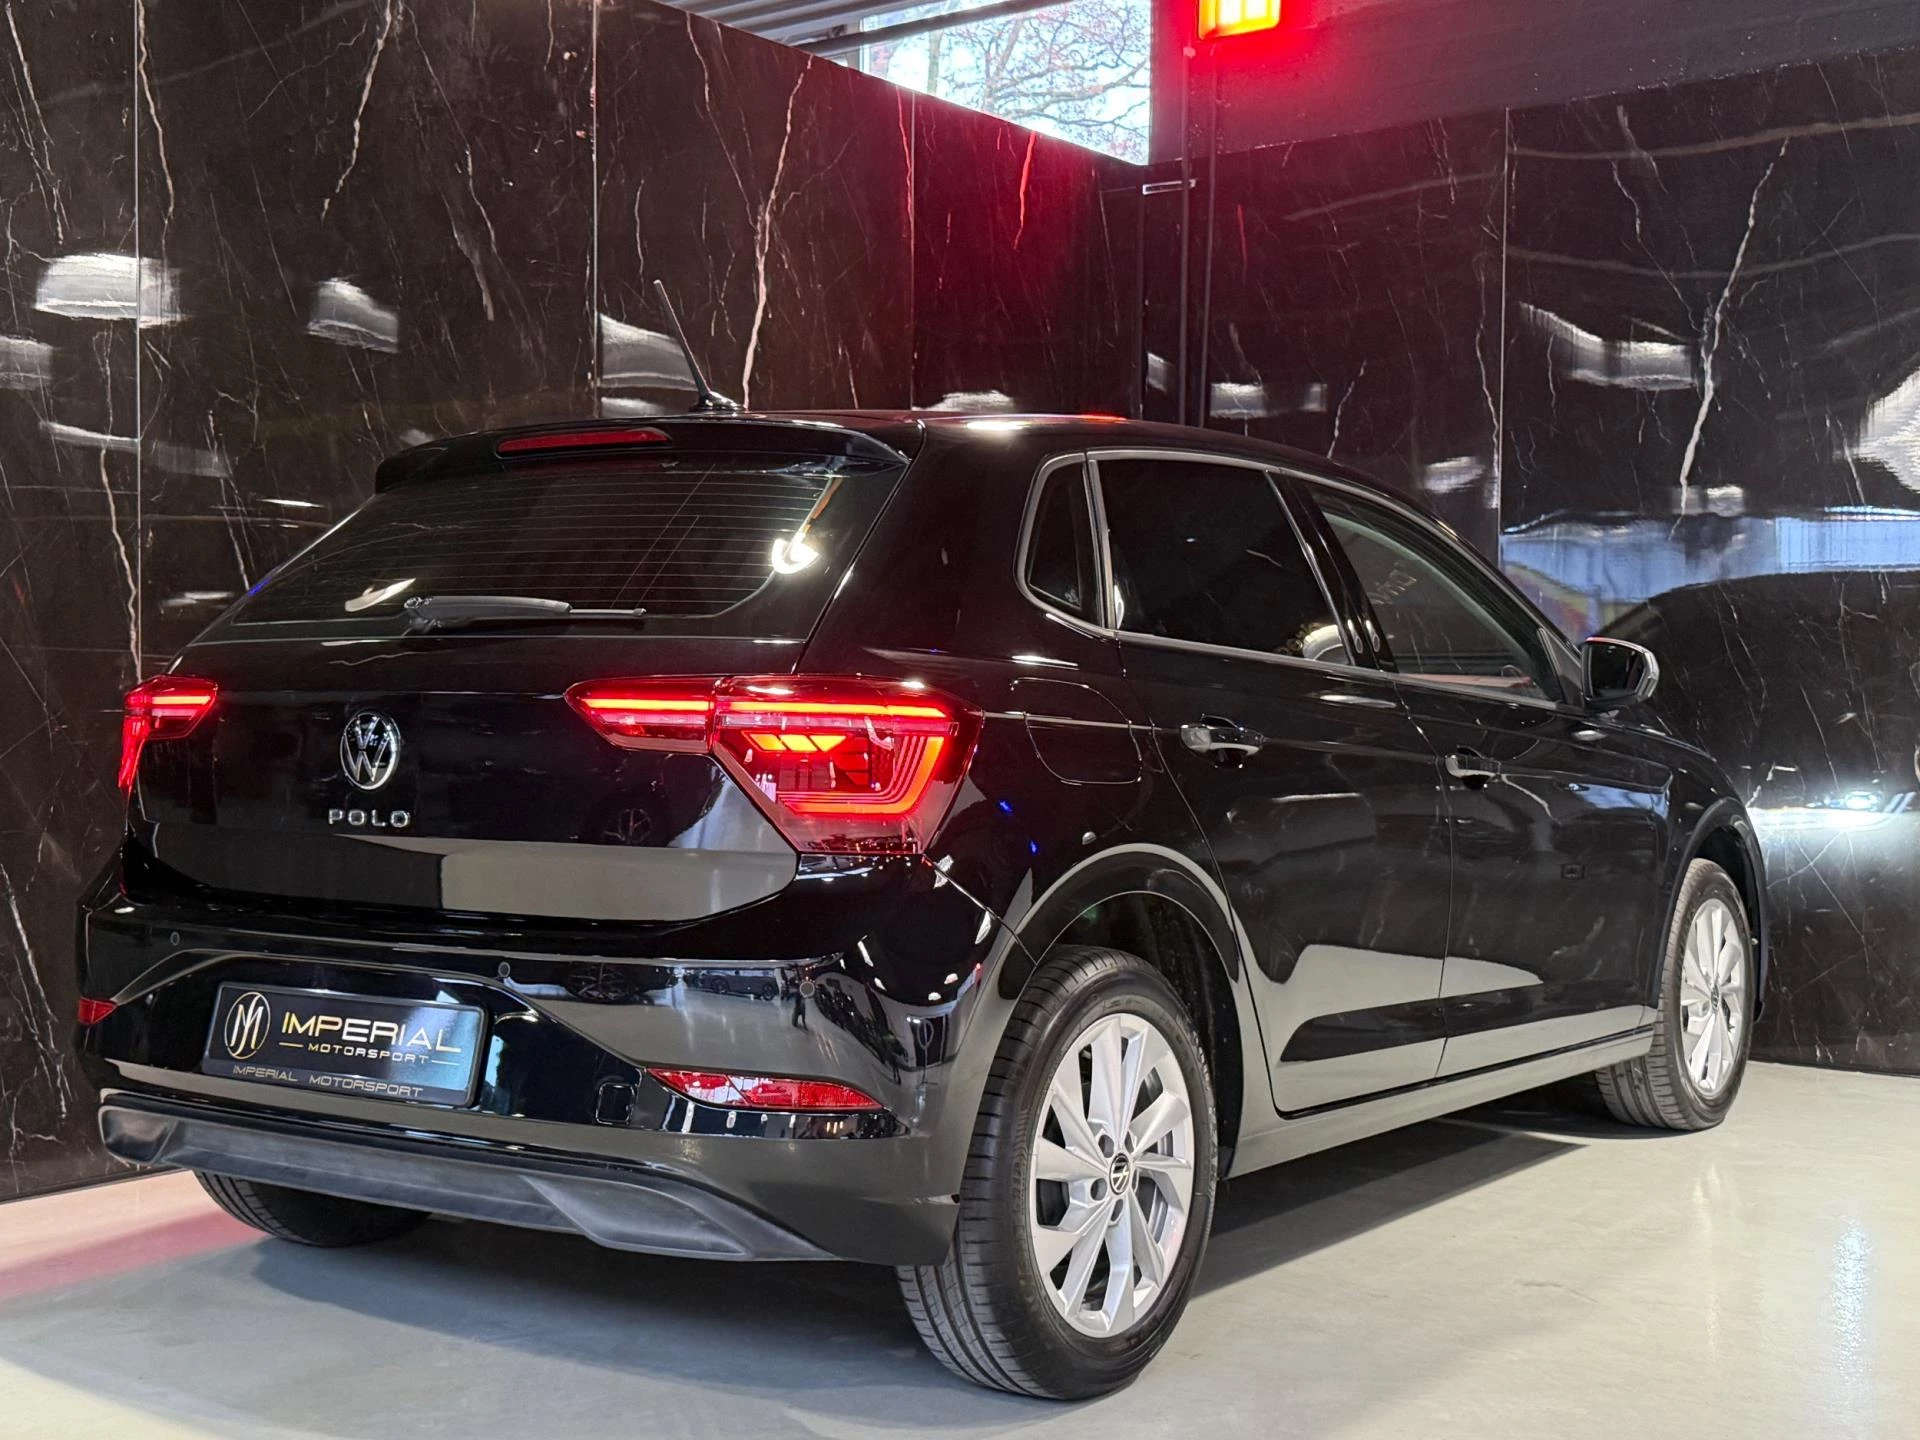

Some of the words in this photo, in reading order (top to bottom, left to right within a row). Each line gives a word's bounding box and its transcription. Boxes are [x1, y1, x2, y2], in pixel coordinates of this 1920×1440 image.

[328, 807, 409, 828] POLO
[282, 1011, 462, 1053] IMPERIAL
[307, 1042, 429, 1064] MOTORSPORT
[232, 1065, 298, 1082] IMPERIAL
[308, 1074, 423, 1098] MOTORSPORT
